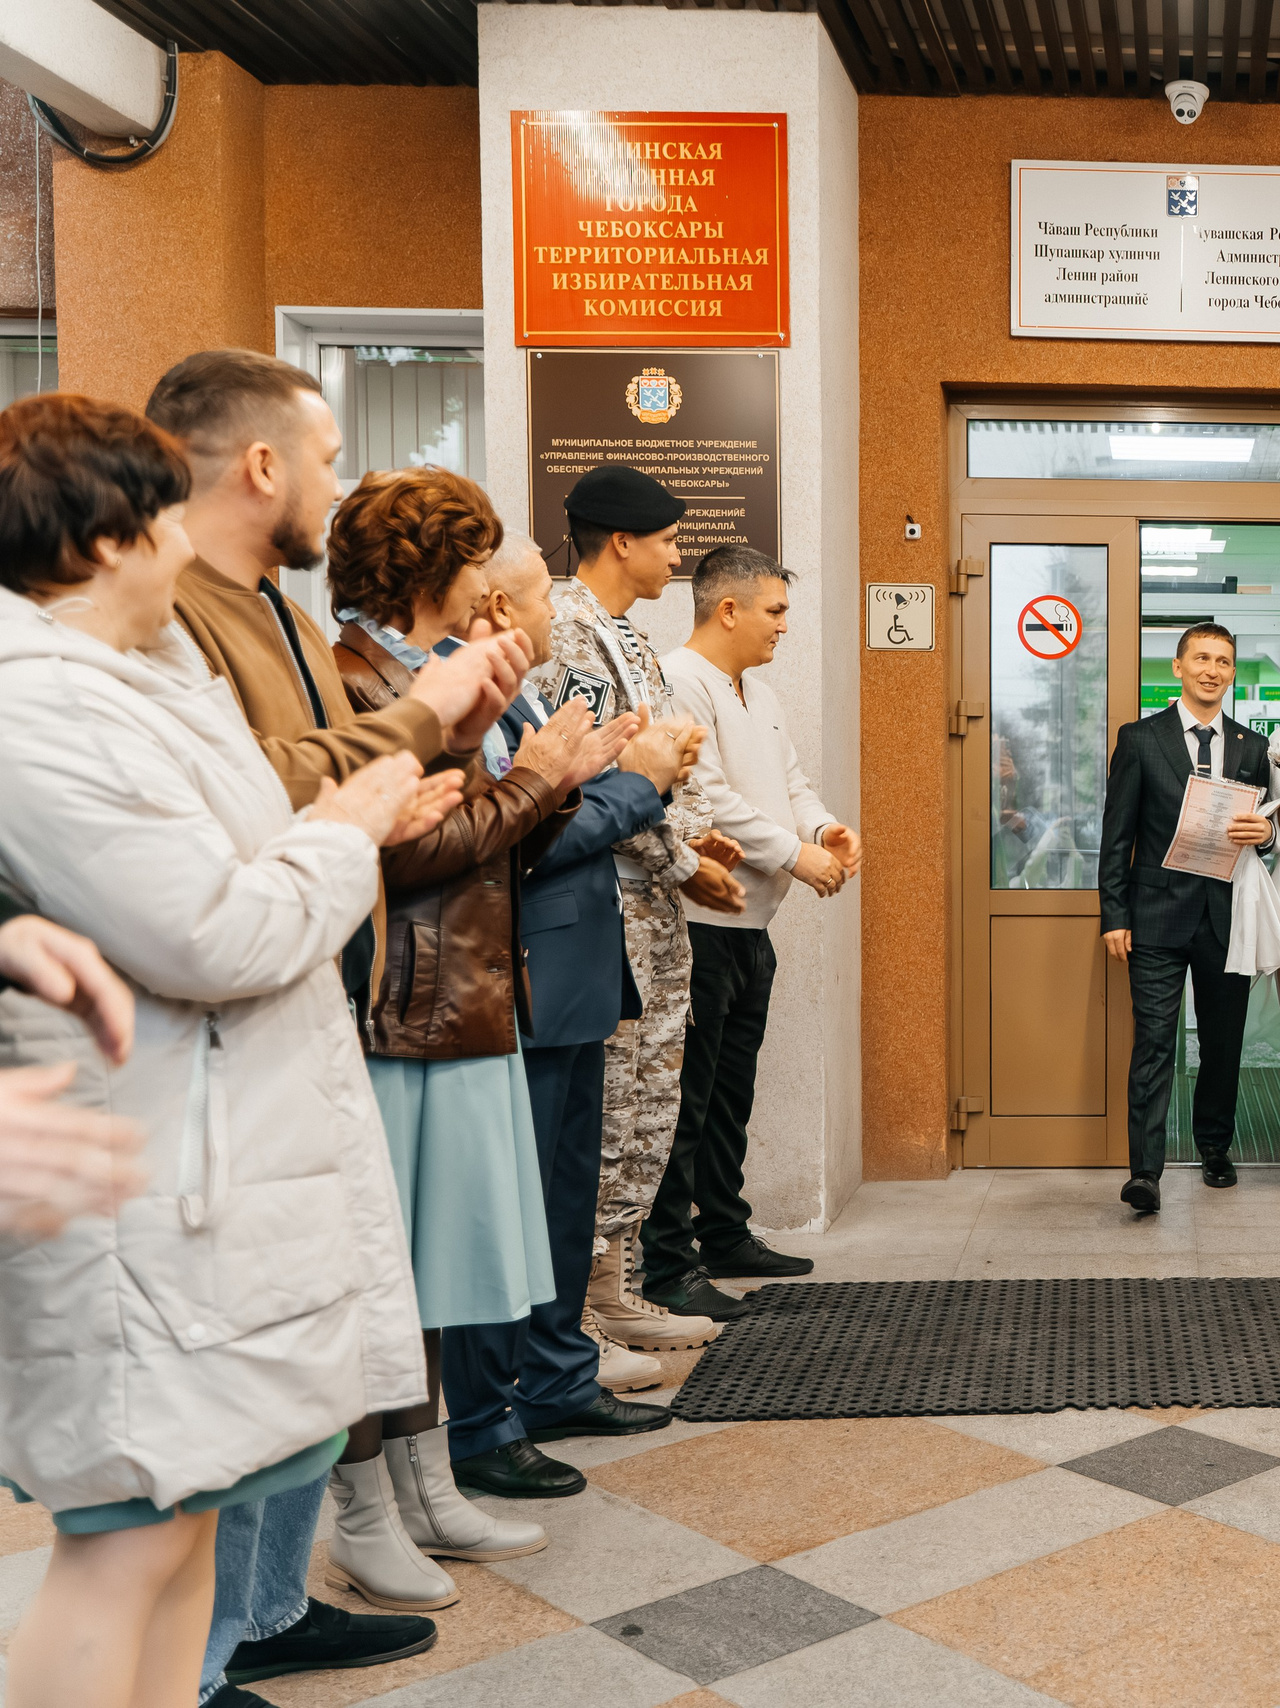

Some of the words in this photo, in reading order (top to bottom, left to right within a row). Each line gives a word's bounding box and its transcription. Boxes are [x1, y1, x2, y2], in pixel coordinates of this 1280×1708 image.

[604, 194, 699, 215] ГОРОДА
[577, 220, 725, 239] ЧЕБОКСАРЫ
[1084, 221, 1159, 242] Республики
[533, 246, 770, 265] ТЕРРИТОРИАЛЬНАЯ
[1034, 243, 1105, 262] Шупашкар
[1108, 247, 1161, 265] хулинчи
[552, 272, 754, 292] ИЗБИРАТЕЛЬНАЯ
[1056, 267, 1098, 284] Ленин
[1100, 269, 1139, 287] район
[1204, 270, 1279, 291] Ленинского
[583, 298, 723, 317] КОМИССИЯ
[1207, 296, 1250, 313] города
[551, 438, 634, 449] МУНИЦИПАЛЬНОЕ
[636, 439, 695, 449] БЮДЖЕТНОЕ
[697, 440, 758, 449] УЧРЕЖДЕНИЕ
[539, 452, 604, 462] «УПРАВЛЕНИЕ
[606, 453, 770, 463] ФИНАНСОВО-ПРОИЗВОДСТВЕННОГО
[702, 466, 763, 476] УЧРЕЖДЕНИЙ
[669, 479, 730, 489] ЧЕБОКСАРЫ»
[698, 536, 748, 544] ФИНАНСПА
